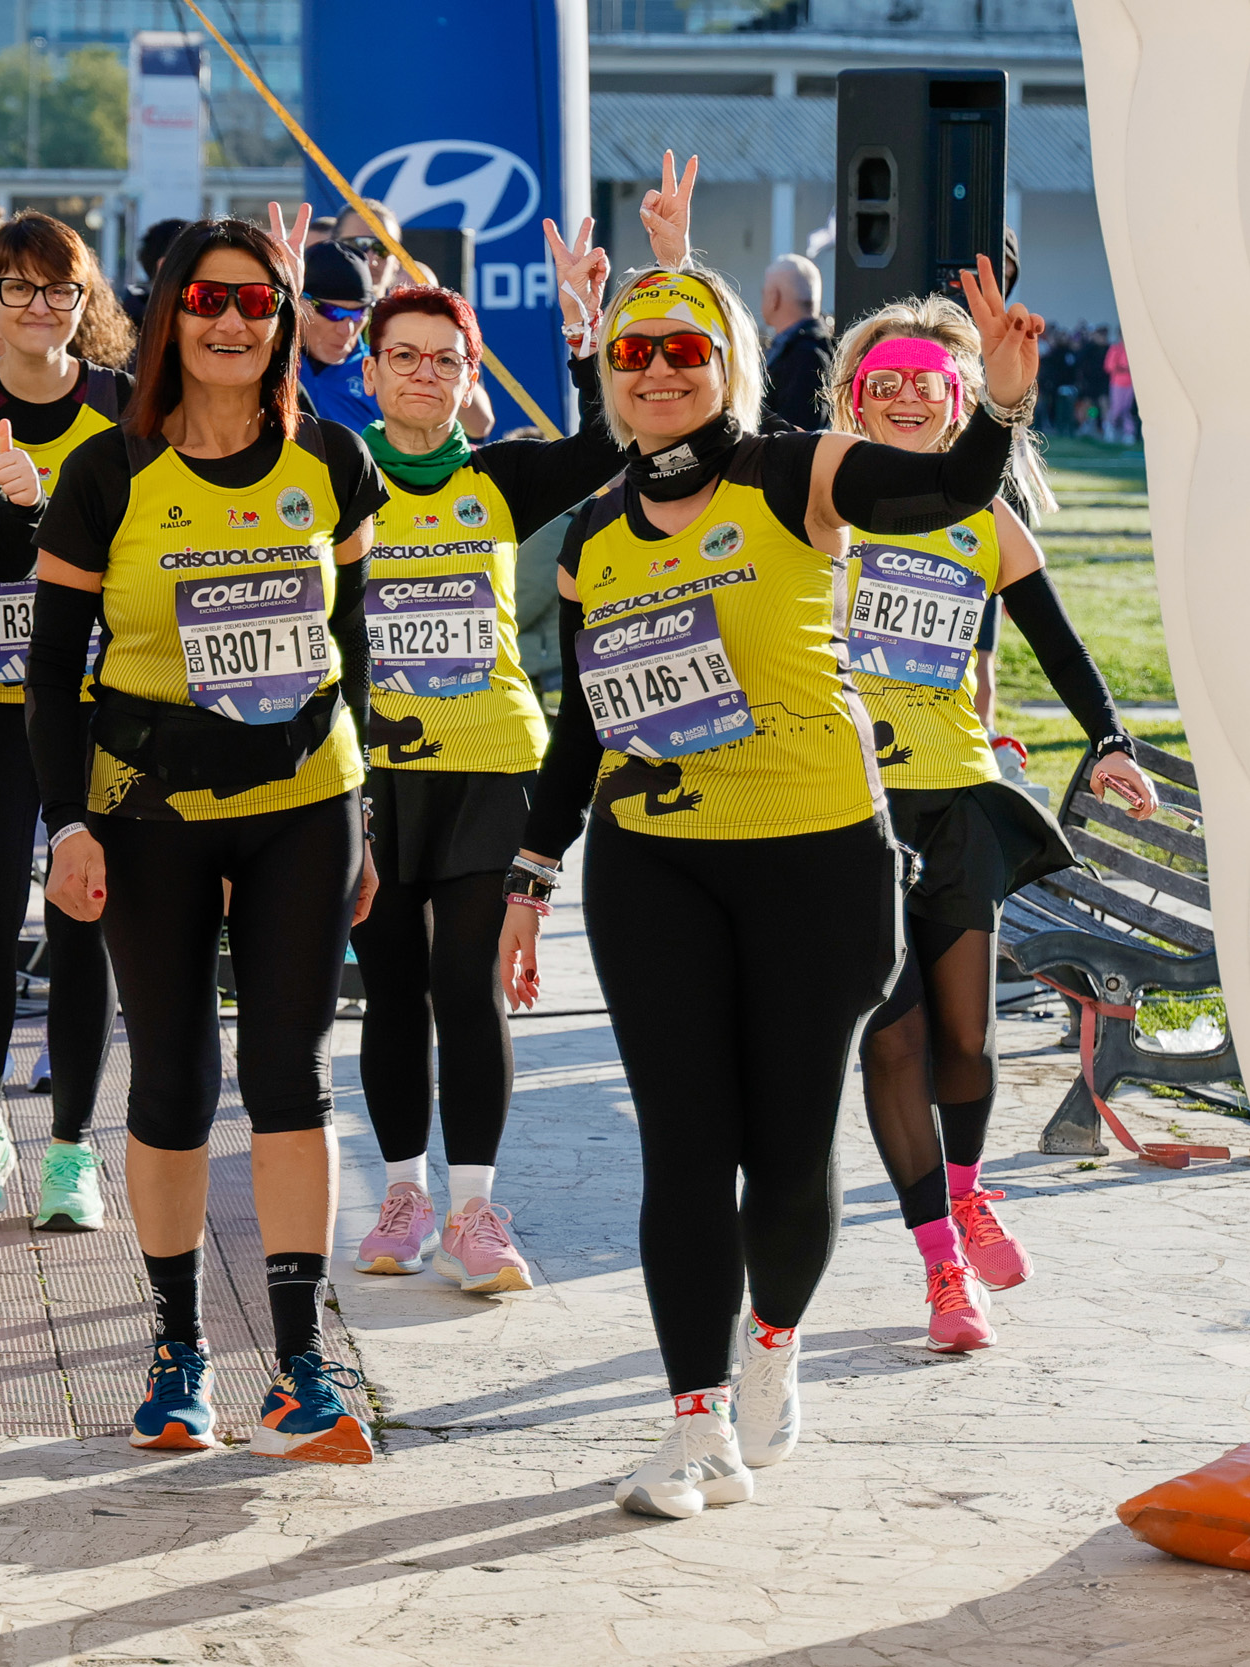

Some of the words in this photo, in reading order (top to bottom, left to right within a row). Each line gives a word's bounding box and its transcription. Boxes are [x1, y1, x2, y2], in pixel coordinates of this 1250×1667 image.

[669, 290, 704, 308] Polla
[160, 520, 192, 530] HALLOP
[876, 552, 967, 586] COELMO
[191, 577, 301, 608] COELMO
[379, 580, 475, 600] COELMO
[594, 576, 617, 590] HALLOP
[200, 606, 230, 614] EXCELLENCE
[260, 599, 297, 607] GENERATIONS
[874, 592, 960, 642] R219-1
[280, 616, 302, 624] MARATHON
[593, 609, 695, 655] COELMO
[388, 618, 472, 654] R223-1
[600, 648, 628, 660] EXCELLENCE
[629, 641, 654, 652] THROUGH
[655, 632, 692, 646] GENERATIONS
[205, 625, 302, 676] R307-1
[604, 656, 710, 719] R146-1
[731, 694, 738, 704] G
[684, 725, 706, 736] NAPOLI
